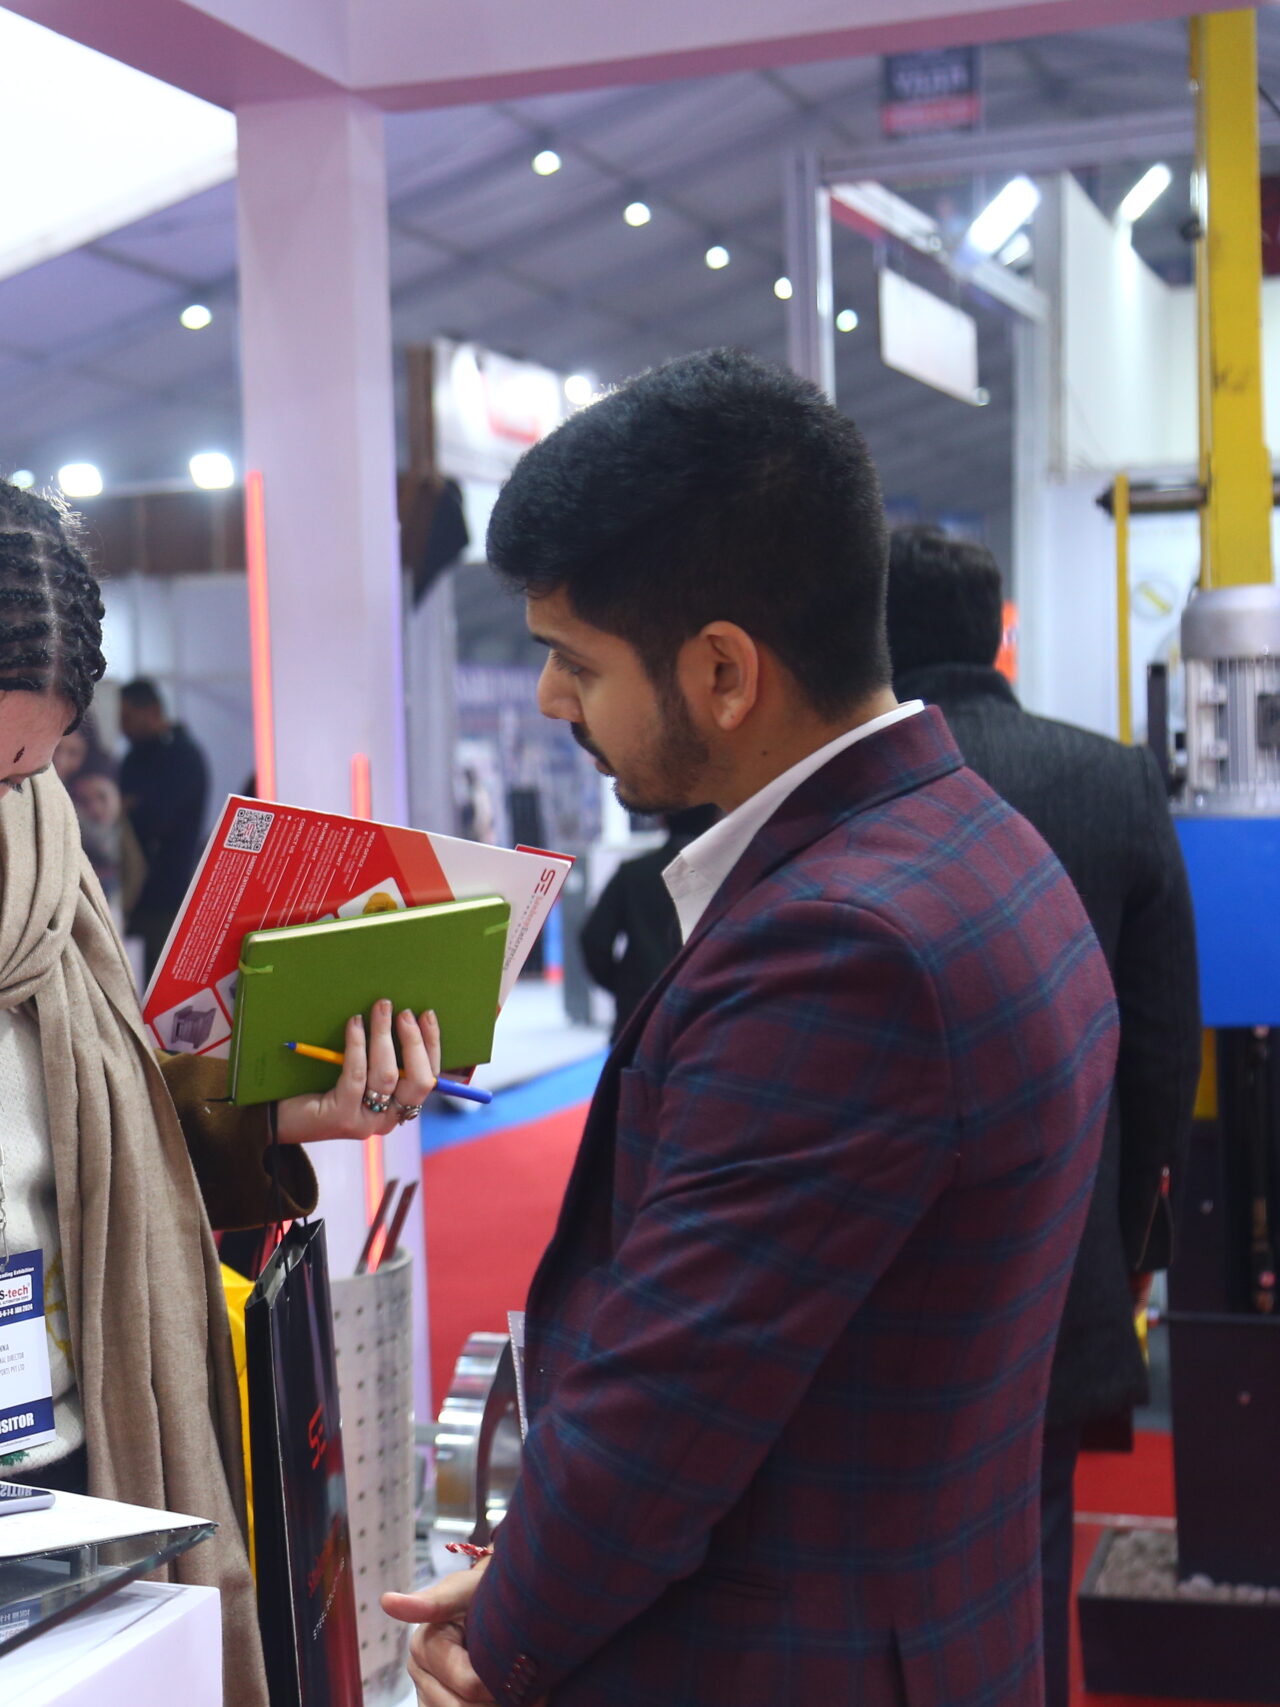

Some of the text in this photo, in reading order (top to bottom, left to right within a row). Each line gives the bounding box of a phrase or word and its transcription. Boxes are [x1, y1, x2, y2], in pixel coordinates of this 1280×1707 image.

[288, 817, 306, 854] CONTACT US
[318, 822, 329, 845] MUMBAI
